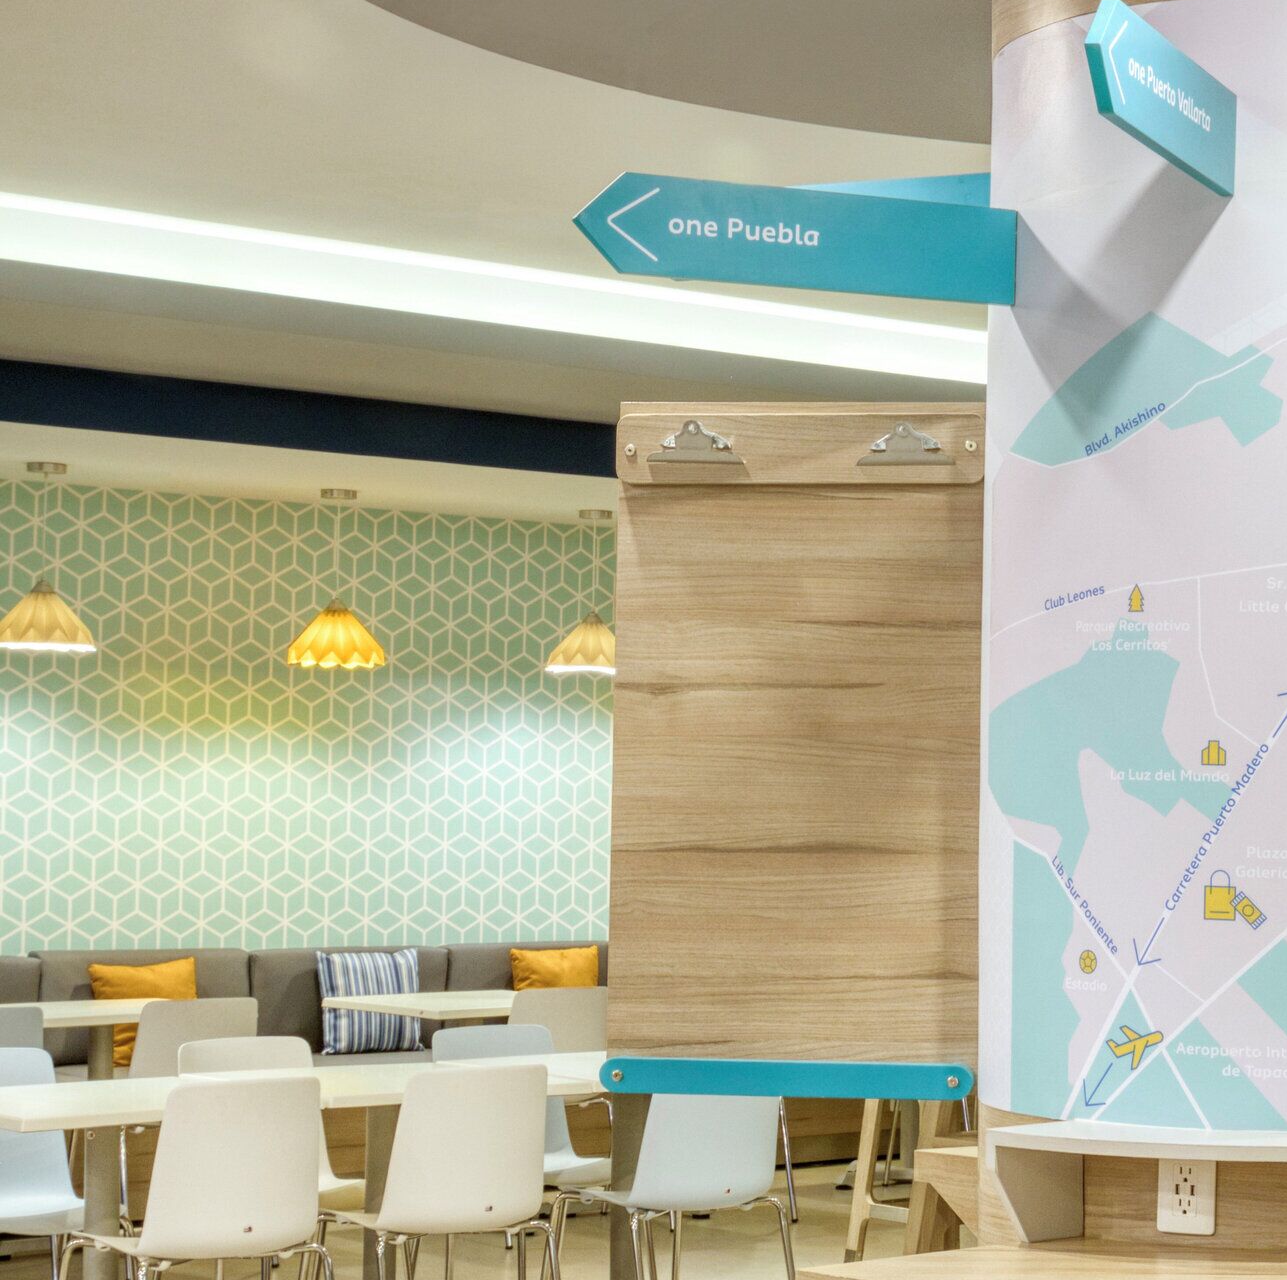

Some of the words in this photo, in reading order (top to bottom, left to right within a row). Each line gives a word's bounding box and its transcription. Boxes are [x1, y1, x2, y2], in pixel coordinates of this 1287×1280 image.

[1128, 57, 1146, 85] one
[1147, 65, 1176, 107] Puerto
[1177, 87, 1211, 132] Vallarta
[668, 217, 718, 237] one
[727, 217, 820, 246] Puebla
[1084, 432, 1113, 456] Blvd.
[1113, 402, 1166, 438] Akishino
[1266, 577, 1287, 590] Sr.
[1044, 596, 1066, 611] Club
[1067, 585, 1105, 603] Leones
[1240, 600, 1280, 613] Little
[1075, 621, 1115, 634] Parque
[1119, 618, 1191, 632] Recreativo
[1110, 768, 1126, 781] La
[1128, 769, 1151, 782] Luz
[1154, 769, 1176, 782] del
[1180, 770, 1230, 783] Mundo
[1164, 845, 1207, 912] Carretera
[1202, 797, 1237, 845] Puerto
[1231, 743, 1270, 797] Madero
[1051, 855, 1066, 880] Lib.
[1064, 877, 1081, 901] Sur
[1079, 899, 1119, 956] Poniente
[1064, 976, 1108, 992] Estadio
[1176, 1042, 1262, 1059] Aeropuerto
[1222, 1064, 1241, 1077] de
